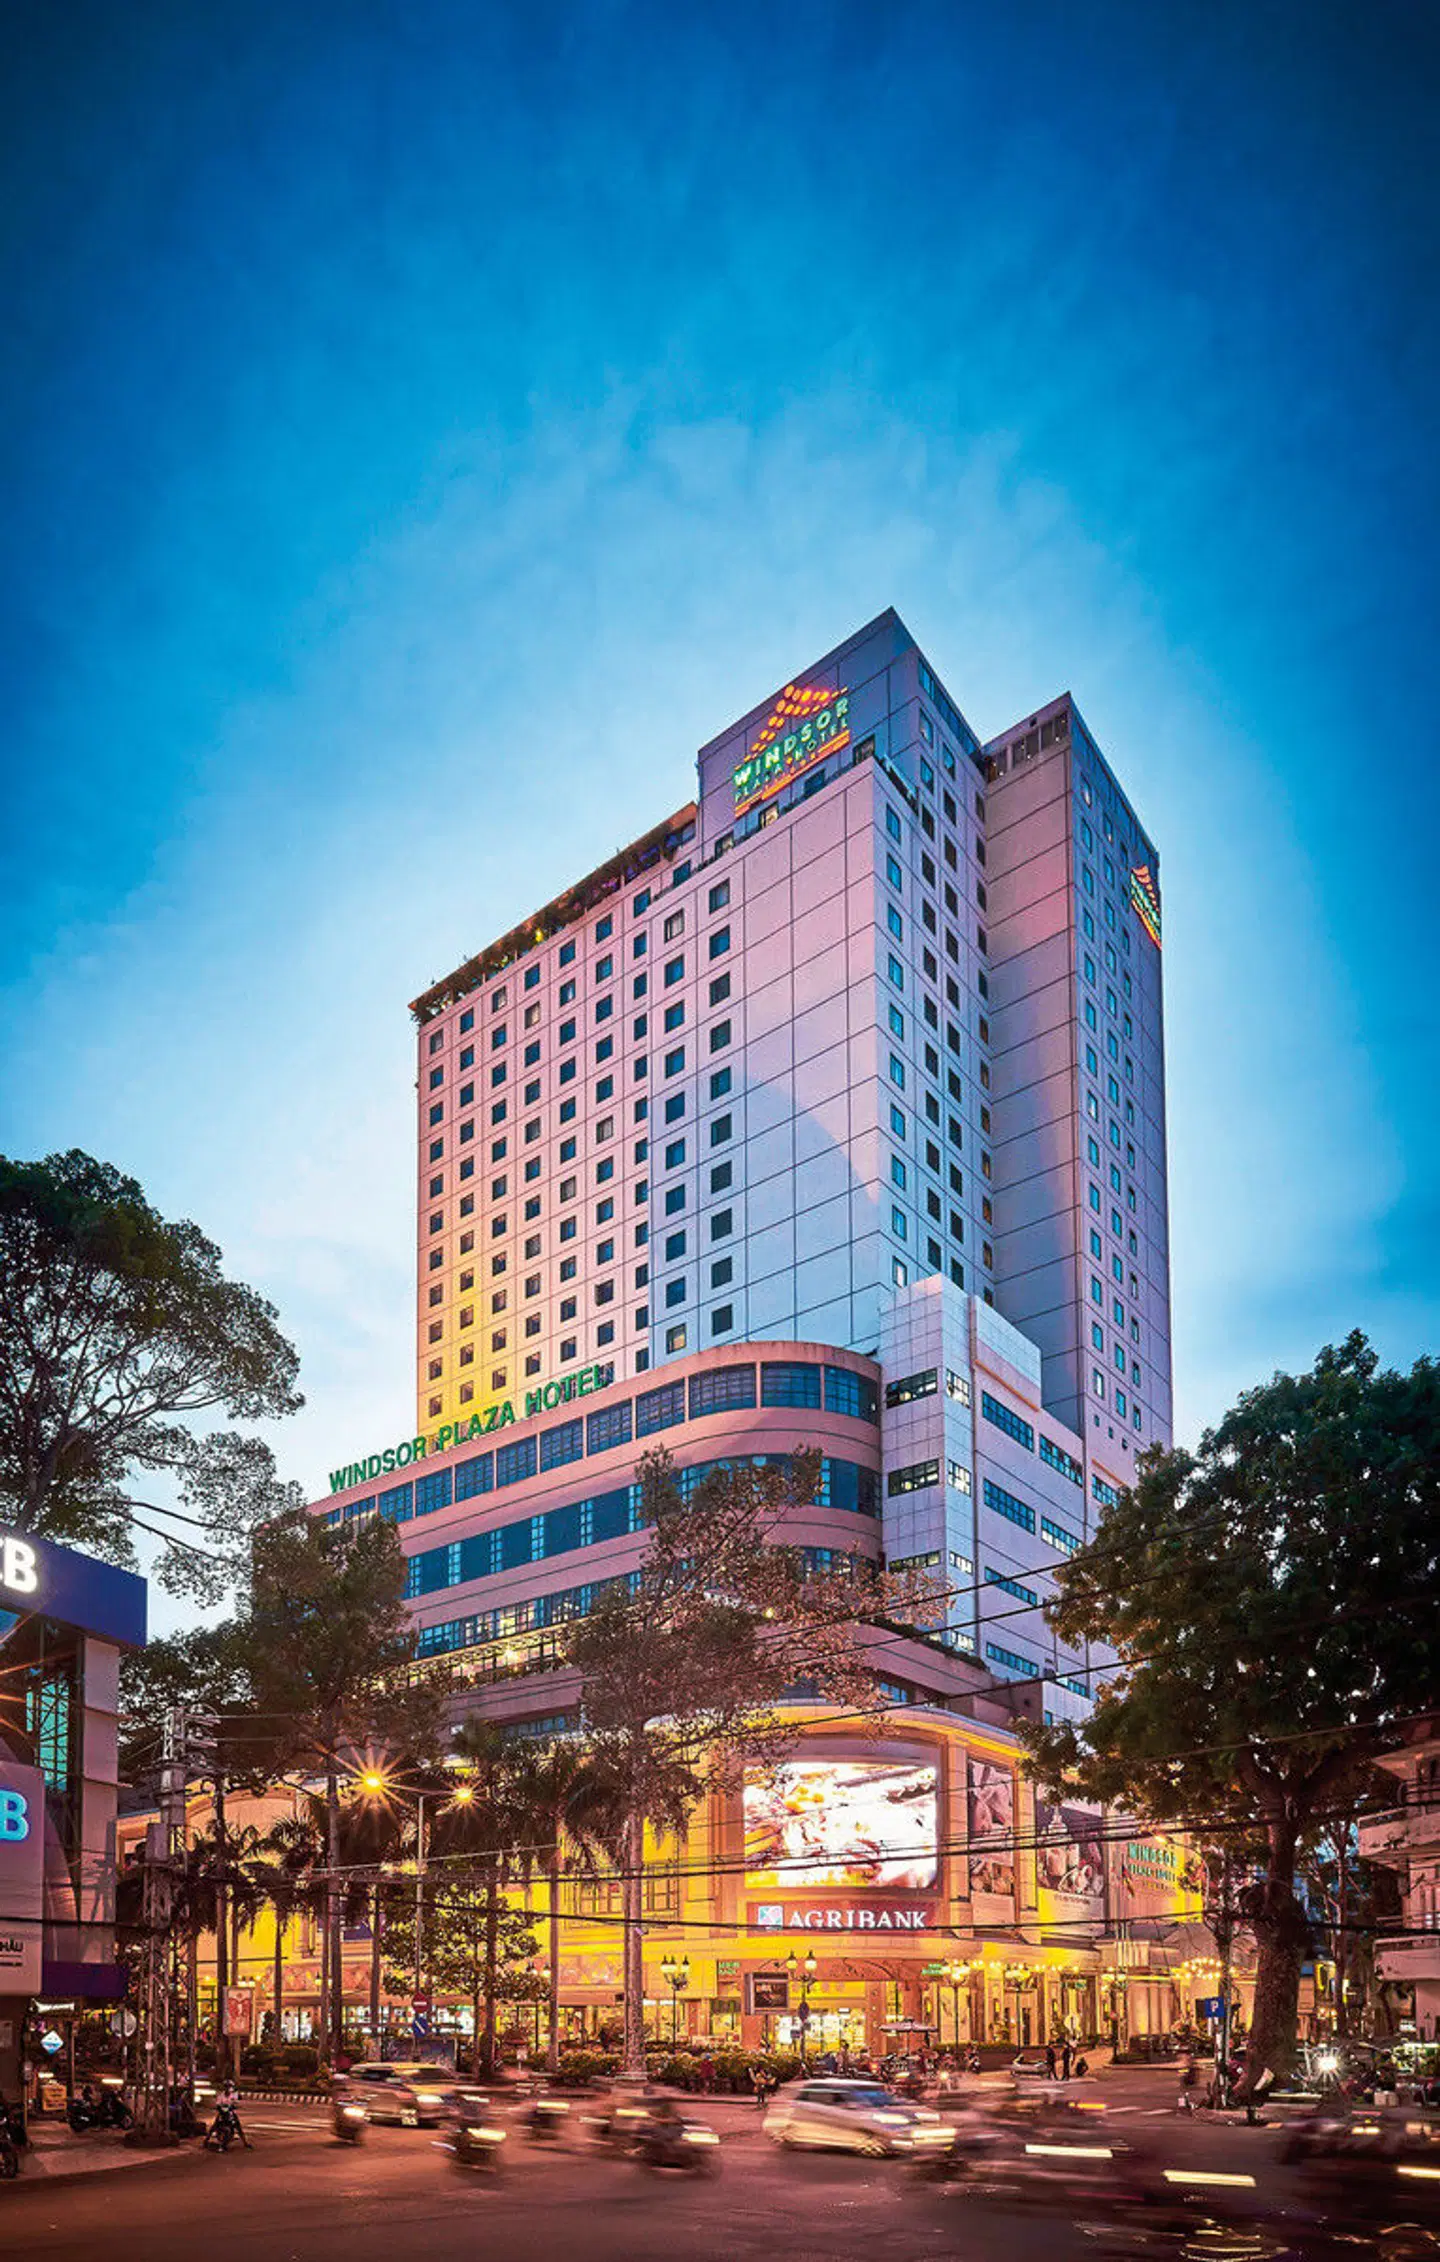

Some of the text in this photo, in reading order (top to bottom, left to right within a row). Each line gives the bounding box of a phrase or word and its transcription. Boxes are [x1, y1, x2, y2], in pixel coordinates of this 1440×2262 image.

[733, 697, 848, 786] WINDSOR
[794, 717, 847, 761] HOTEL
[328, 1363, 610, 1493] WINDSOR PLAZA HOTEL
[789, 1910, 928, 1929] AGRIBANK
